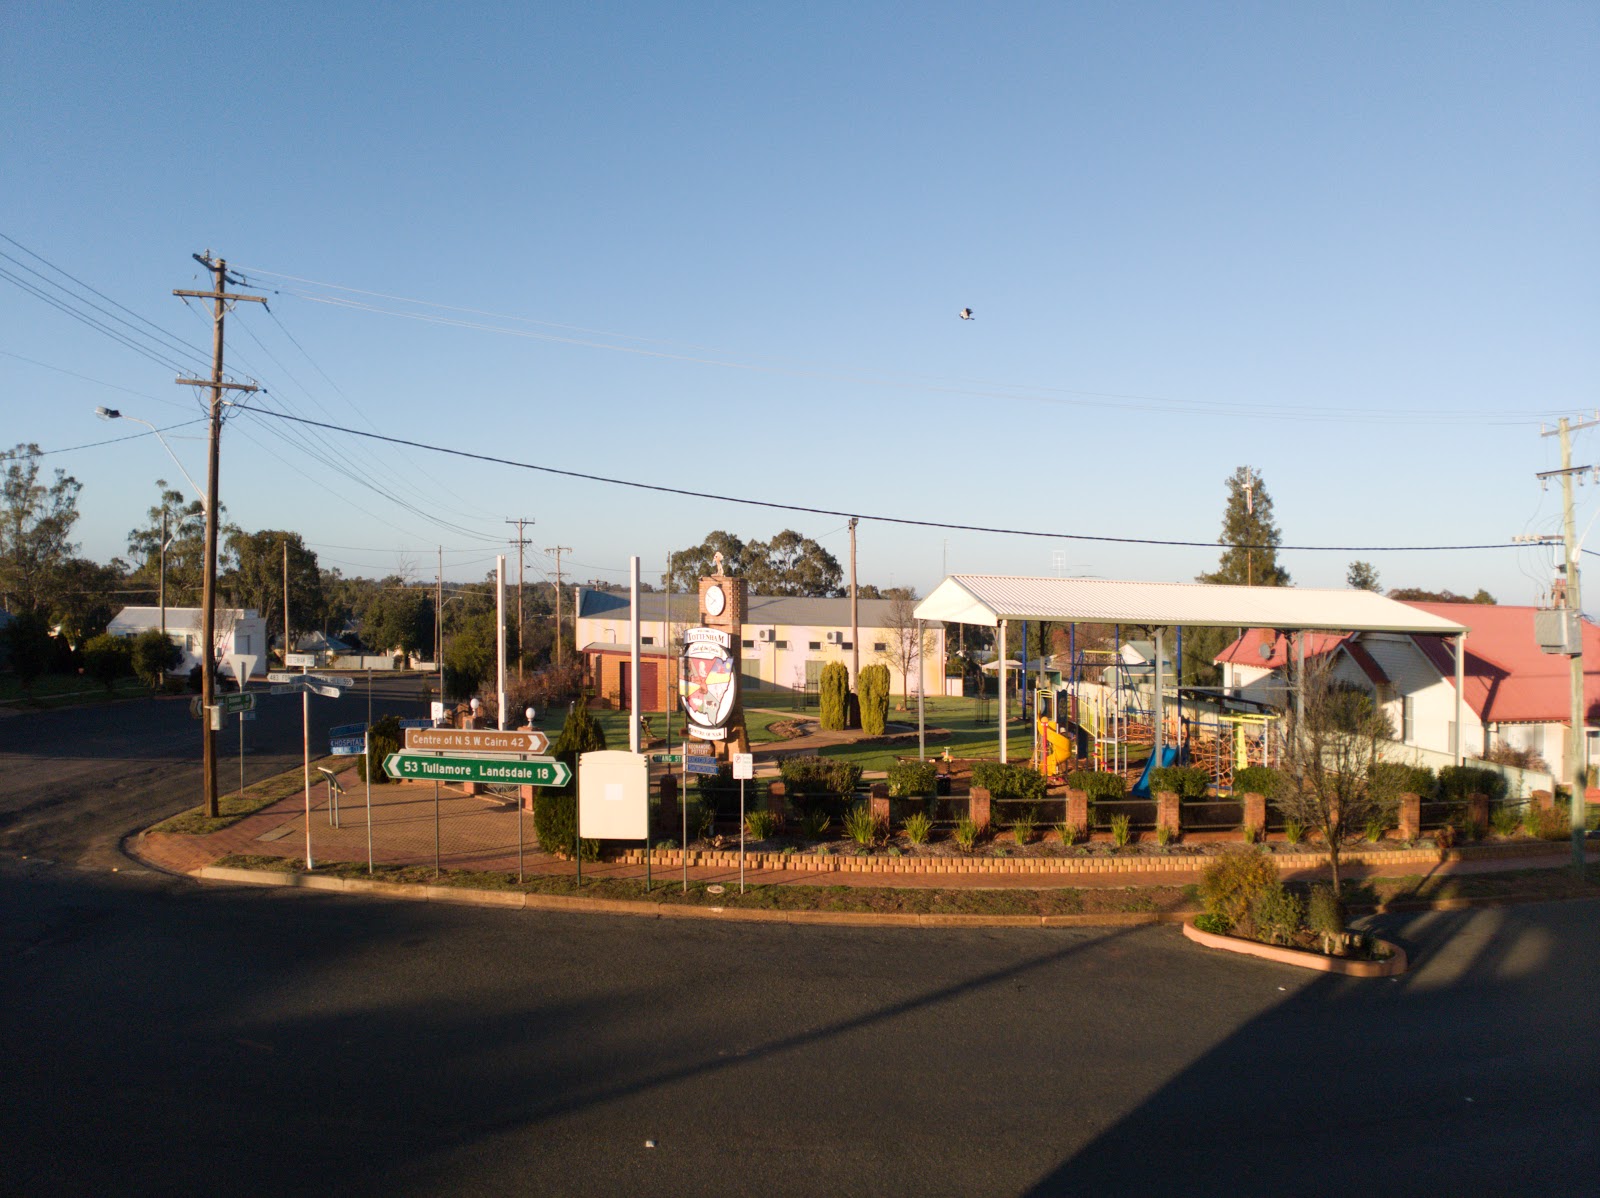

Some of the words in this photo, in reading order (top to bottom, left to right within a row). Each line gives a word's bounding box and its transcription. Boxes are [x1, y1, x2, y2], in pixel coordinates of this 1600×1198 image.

[687, 632, 724, 643] TOTTENHAM
[334, 739, 364, 747] HOSPITAL
[412, 734, 441, 745] Centre
[444, 736, 452, 744] of
[484, 737, 508, 746] Cairn
[510, 738, 524, 747] 42
[404, 761, 418, 772] 53
[421, 762, 471, 775] Tullamore
[479, 765, 532, 778] Landsdale
[537, 768, 549, 779] 18
